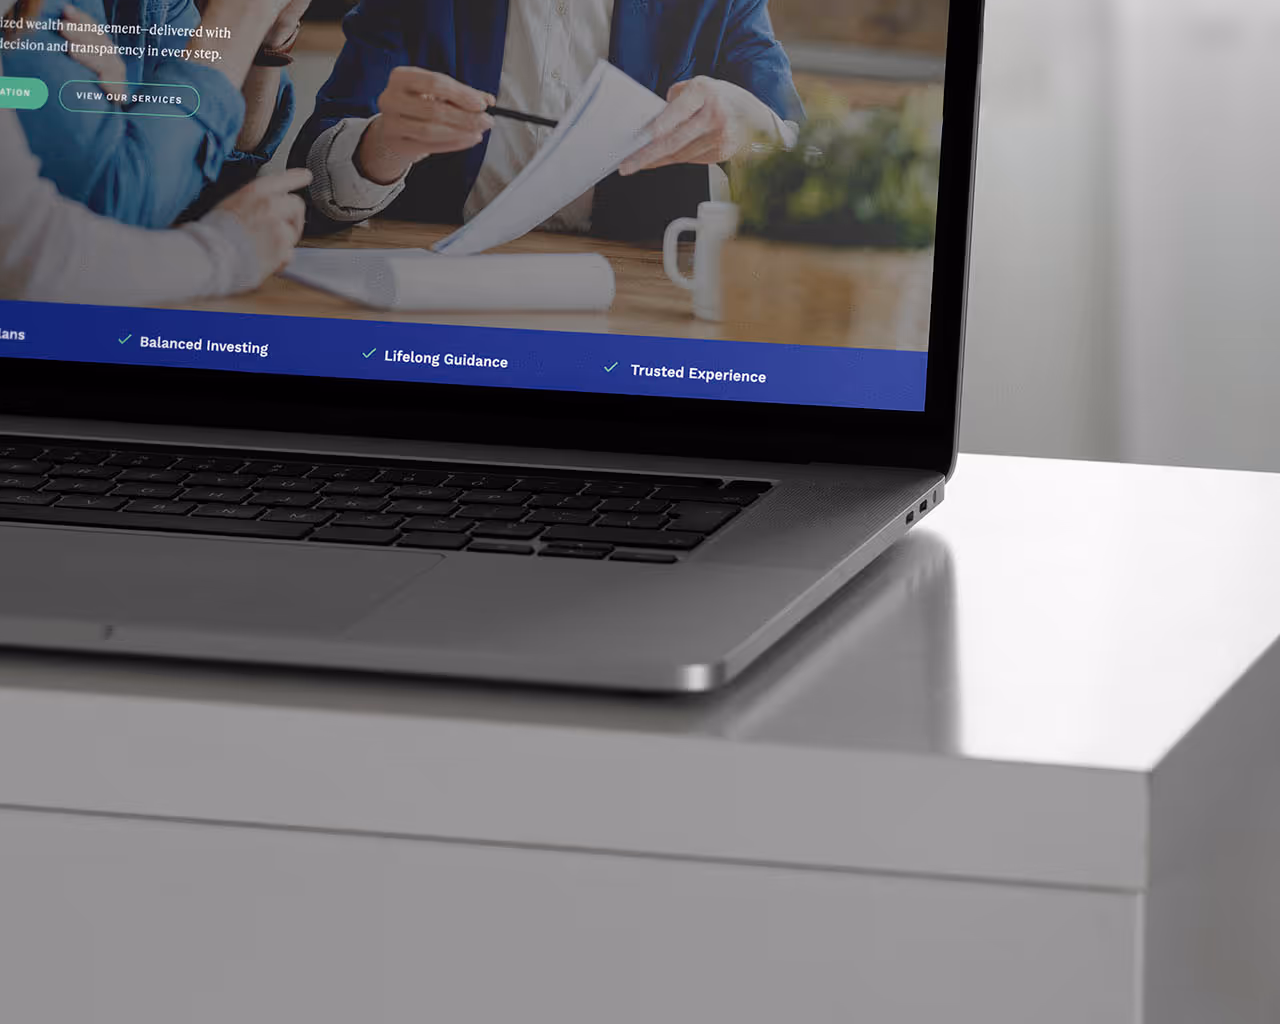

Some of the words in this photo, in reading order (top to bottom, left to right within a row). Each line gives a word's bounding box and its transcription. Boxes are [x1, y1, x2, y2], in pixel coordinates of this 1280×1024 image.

[26, 18, 64, 32] wealth
[205, 26, 231, 39] with
[46, 41, 69, 53] and
[70, 42, 146, 59] transparency
[147, 45, 159, 57] in
[161, 47, 191, 61] every
[194, 49, 223, 63] step.
[76, 91, 102, 101] VIEW
[106, 93, 128, 102] OUR
[131, 94, 183, 105] SERVICES
[140, 336, 203, 351] Balanced
[206, 339, 270, 358] Investing
[384, 350, 441, 367] Lifelong
[443, 353, 509, 369] Guidance
[630, 364, 685, 379] Trusted
[688, 367, 767, 383] Experience
